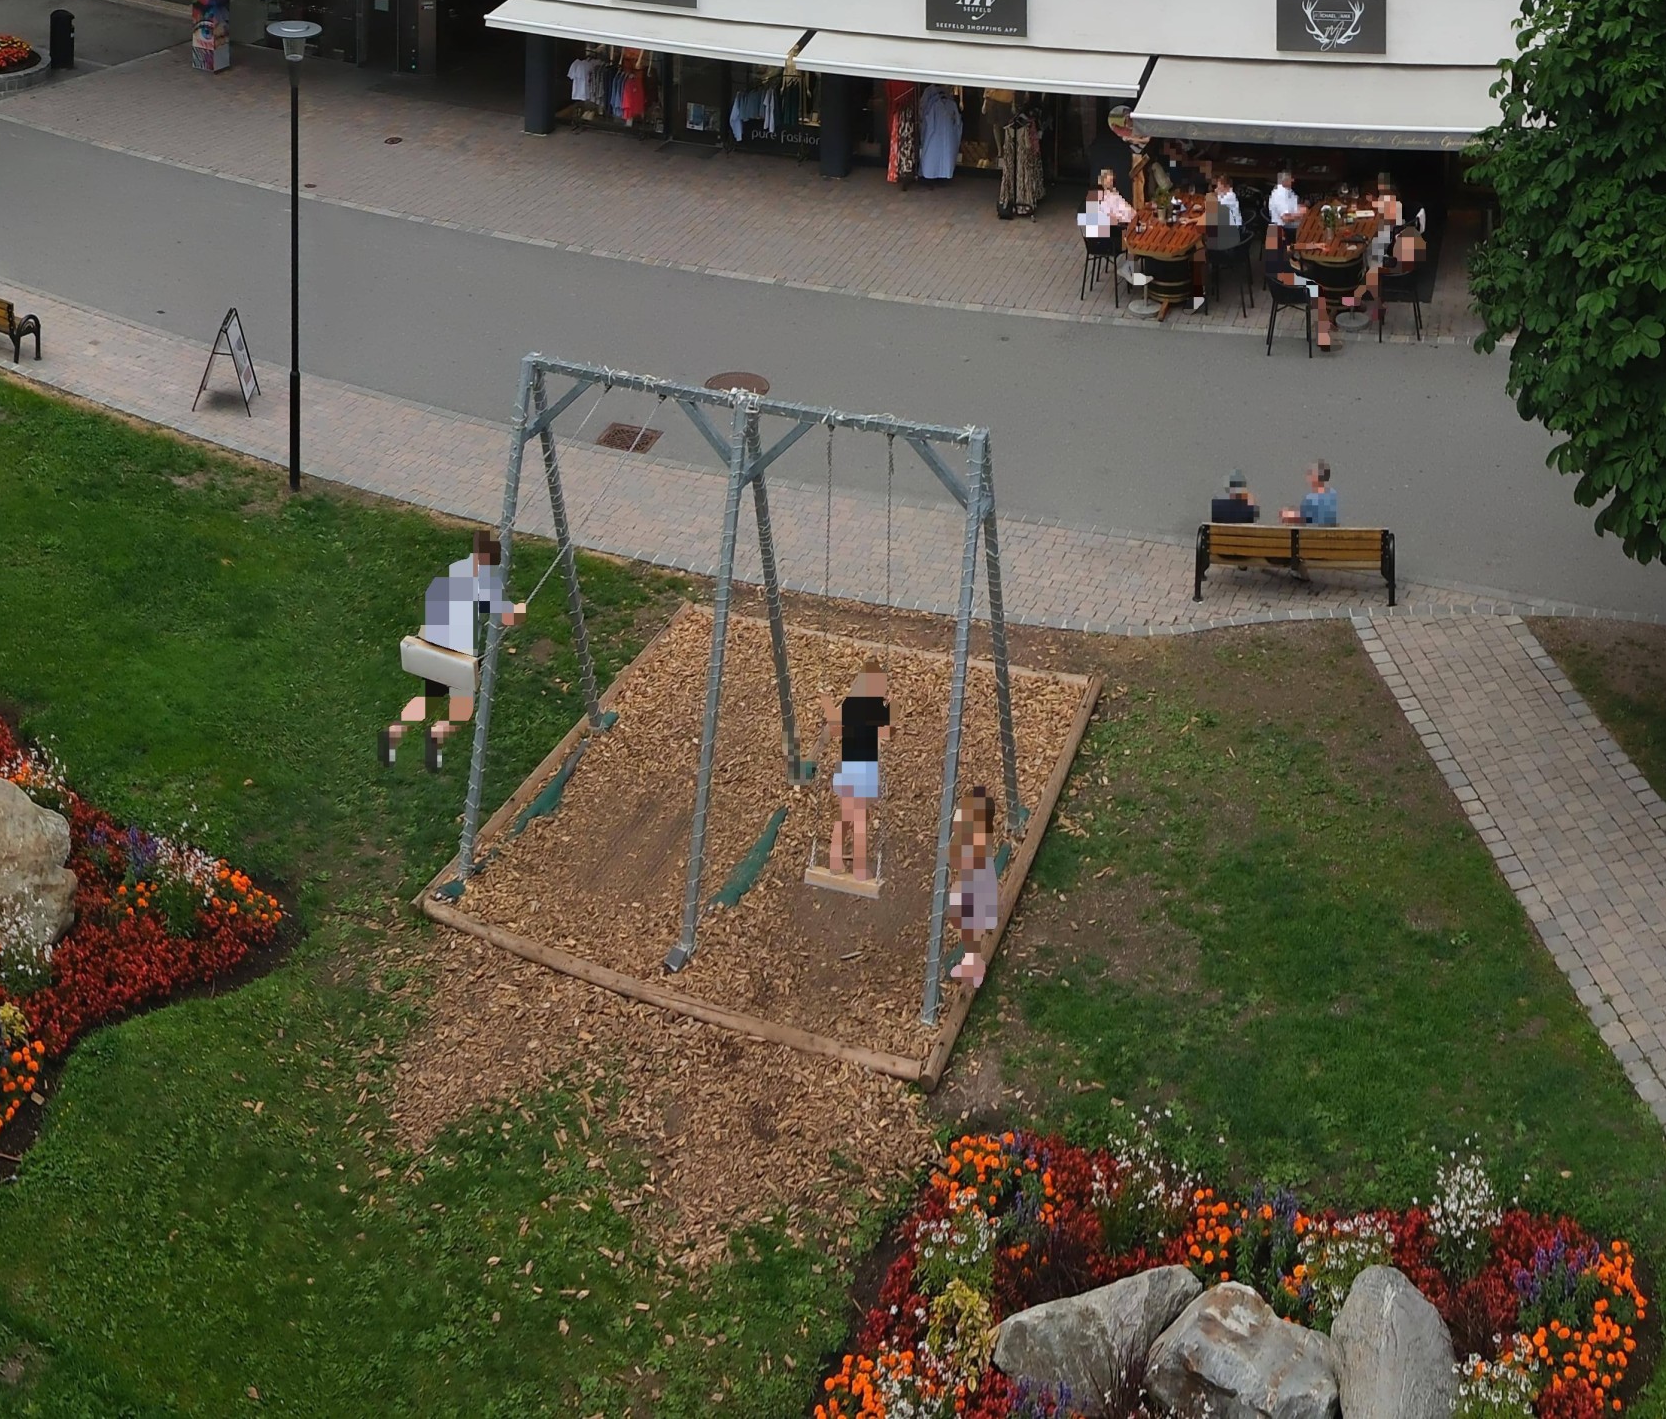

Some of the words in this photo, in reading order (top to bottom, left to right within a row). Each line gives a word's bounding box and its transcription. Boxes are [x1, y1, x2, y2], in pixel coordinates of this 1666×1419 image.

[935, 22, 965, 30] SEEFELD
[967, 24, 1002, 32] SHOPPING
[751, 129, 777, 141] pure
